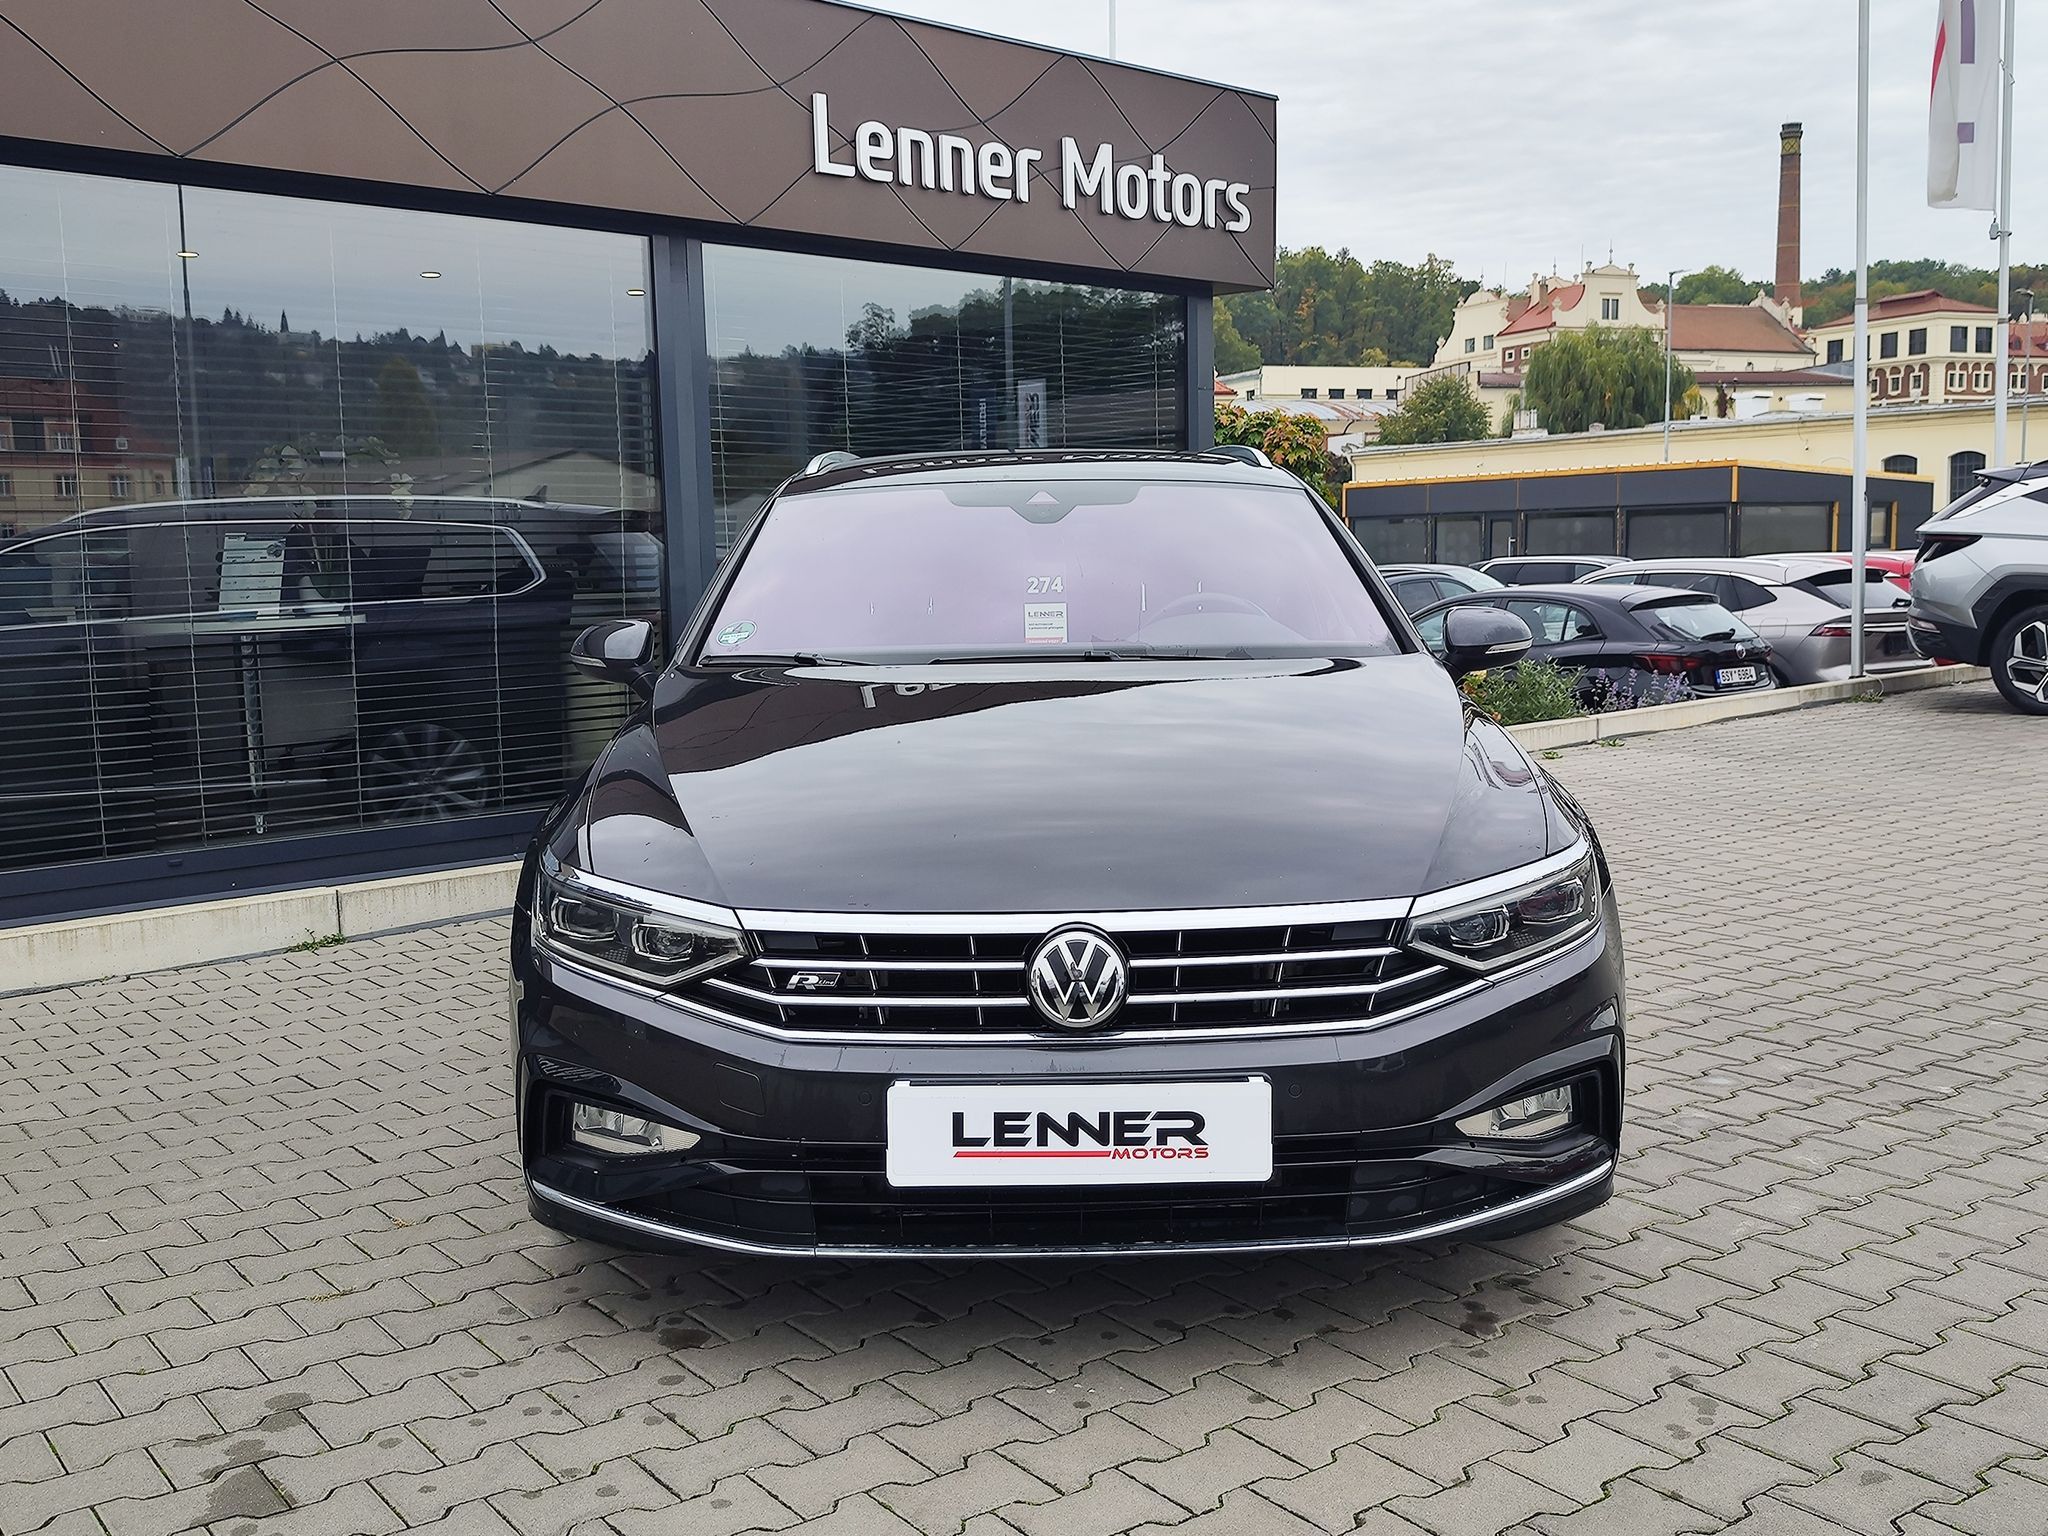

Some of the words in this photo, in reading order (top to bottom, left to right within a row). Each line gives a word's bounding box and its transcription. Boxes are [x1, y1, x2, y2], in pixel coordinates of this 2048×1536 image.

[812, 92, 1043, 203] Lenner
[1061, 135, 1251, 232] Motors
[1026, 576, 1064, 594] 274
[952, 1111, 1209, 1147] LENNER
[1112, 1148, 1209, 1160] MOTORS
